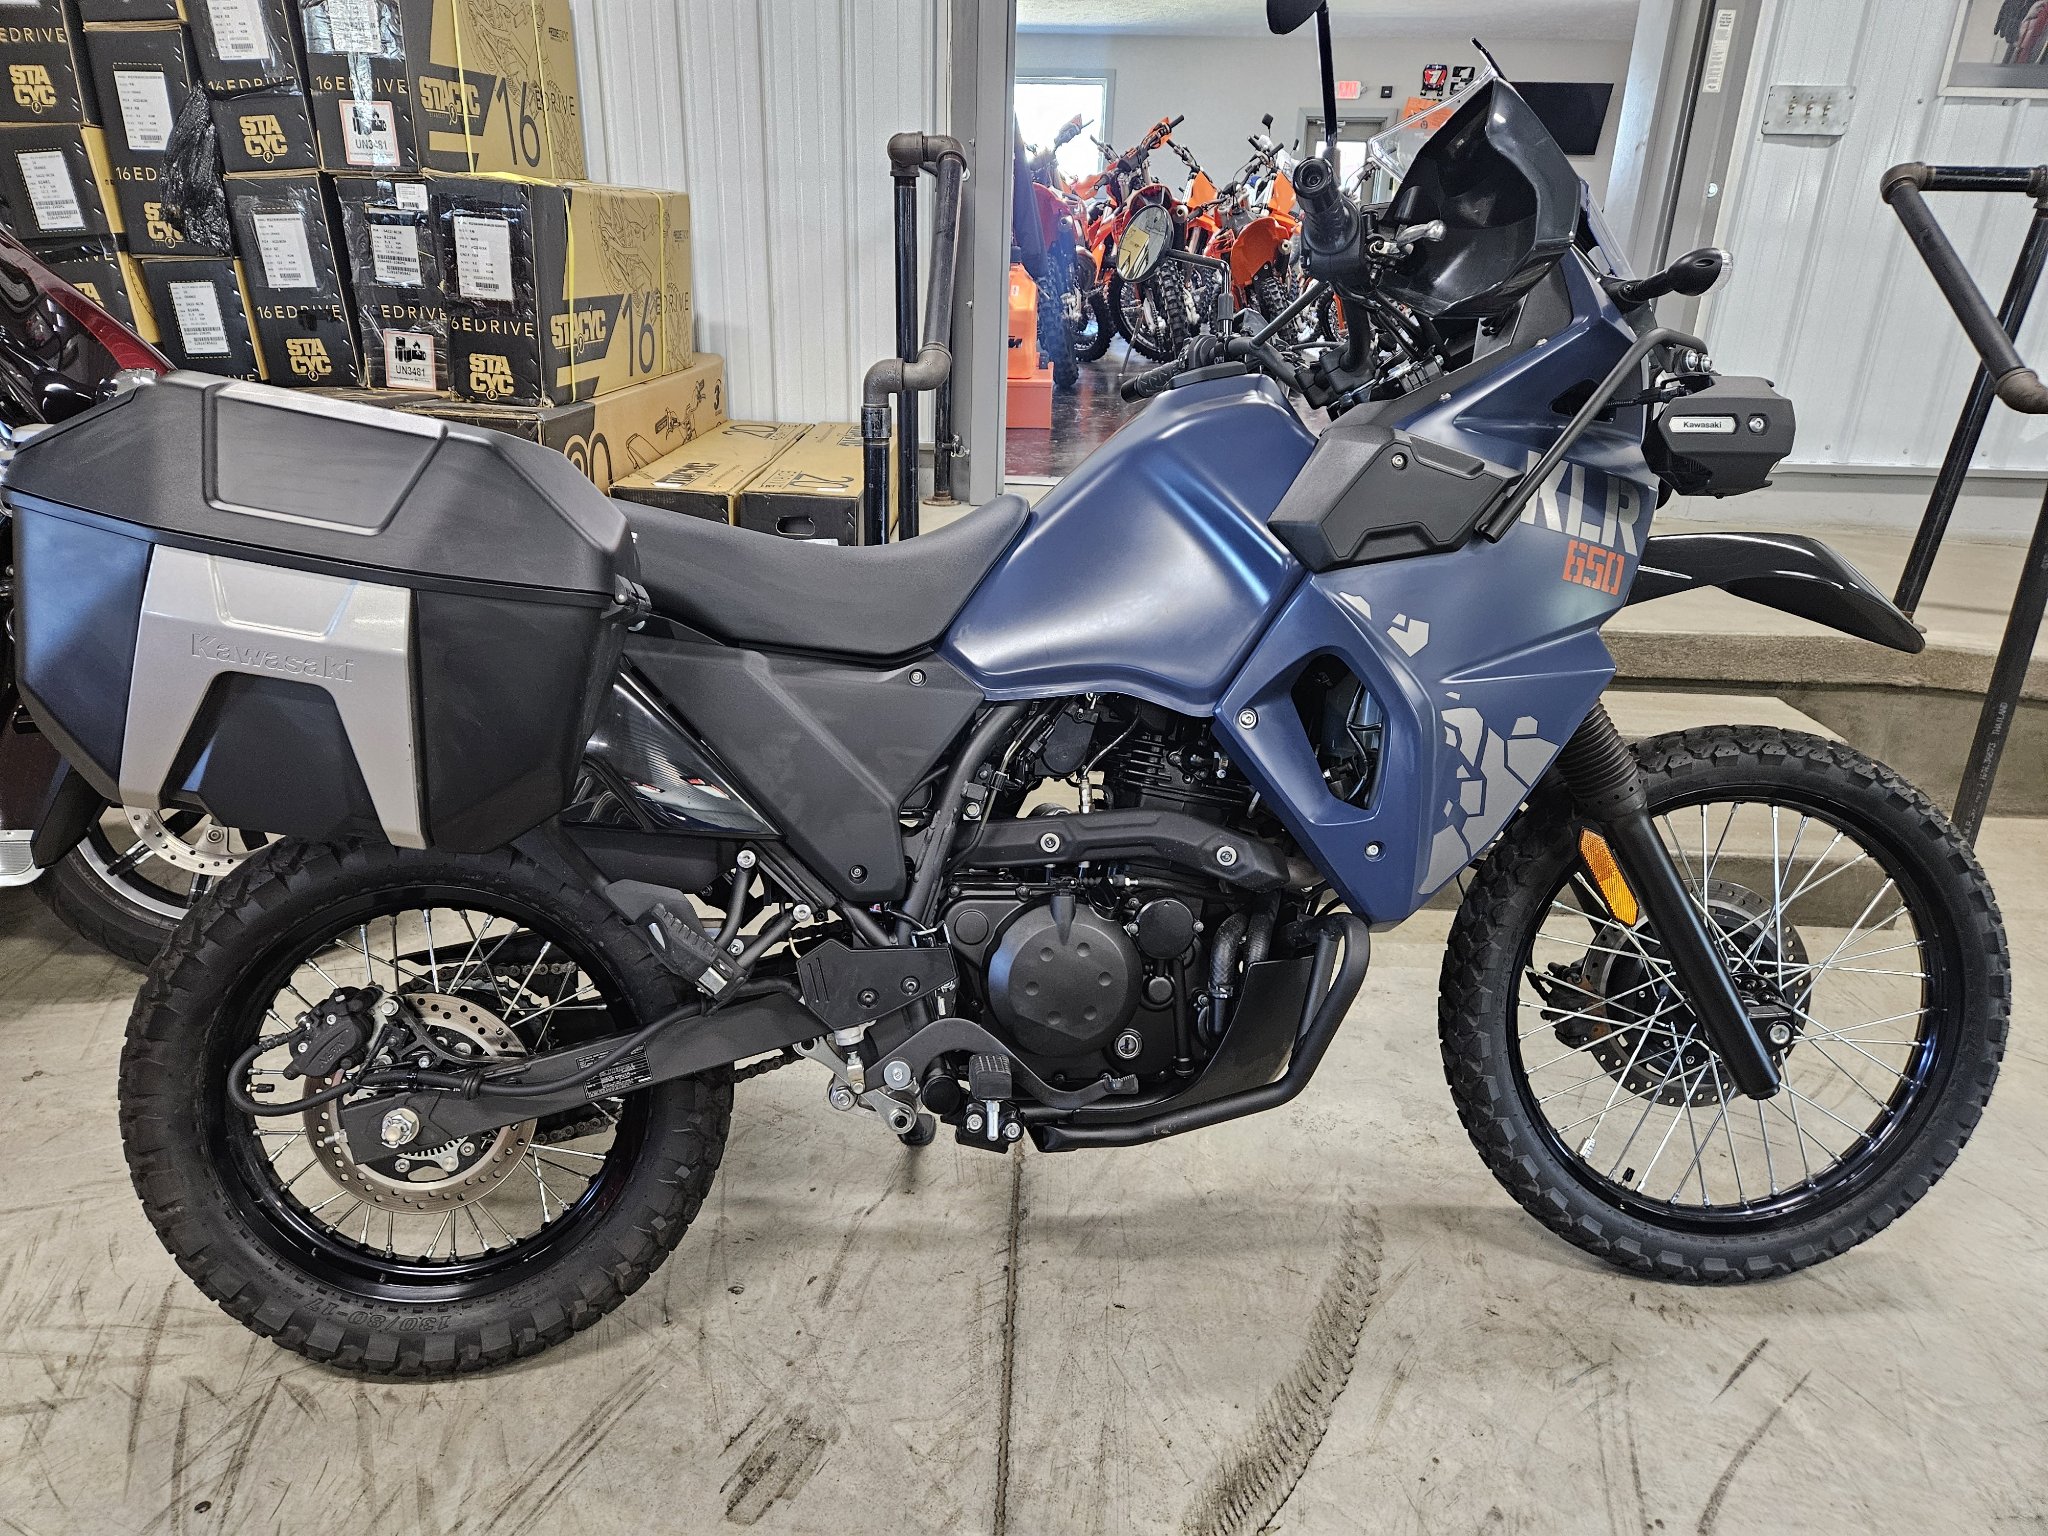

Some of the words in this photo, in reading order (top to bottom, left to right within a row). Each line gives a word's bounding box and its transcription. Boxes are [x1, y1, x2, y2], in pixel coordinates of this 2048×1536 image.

[9, 64, 52, 85] STA
[13, 84, 57, 105] CYC
[239, 114, 283, 136] STA
[496, 77, 541, 168] 16
[243, 134, 288, 155] CYC
[355, 139, 388, 150] UN381
[622, 290, 656, 378] 16
[286, 338, 328, 356] STA
[290, 355, 332, 374] CYC
[395, 365, 426, 377] UN3481
[469, 353, 512, 376] STA
[469, 371, 514, 394] CYC
[1683, 420, 1722, 429] Kawasaki
[1520, 450, 1641, 556] KLR
[1561, 540, 1625, 595] 650
[192, 633, 354, 682] Kawasaki
[303, 1297, 452, 1332] 130/80-17
